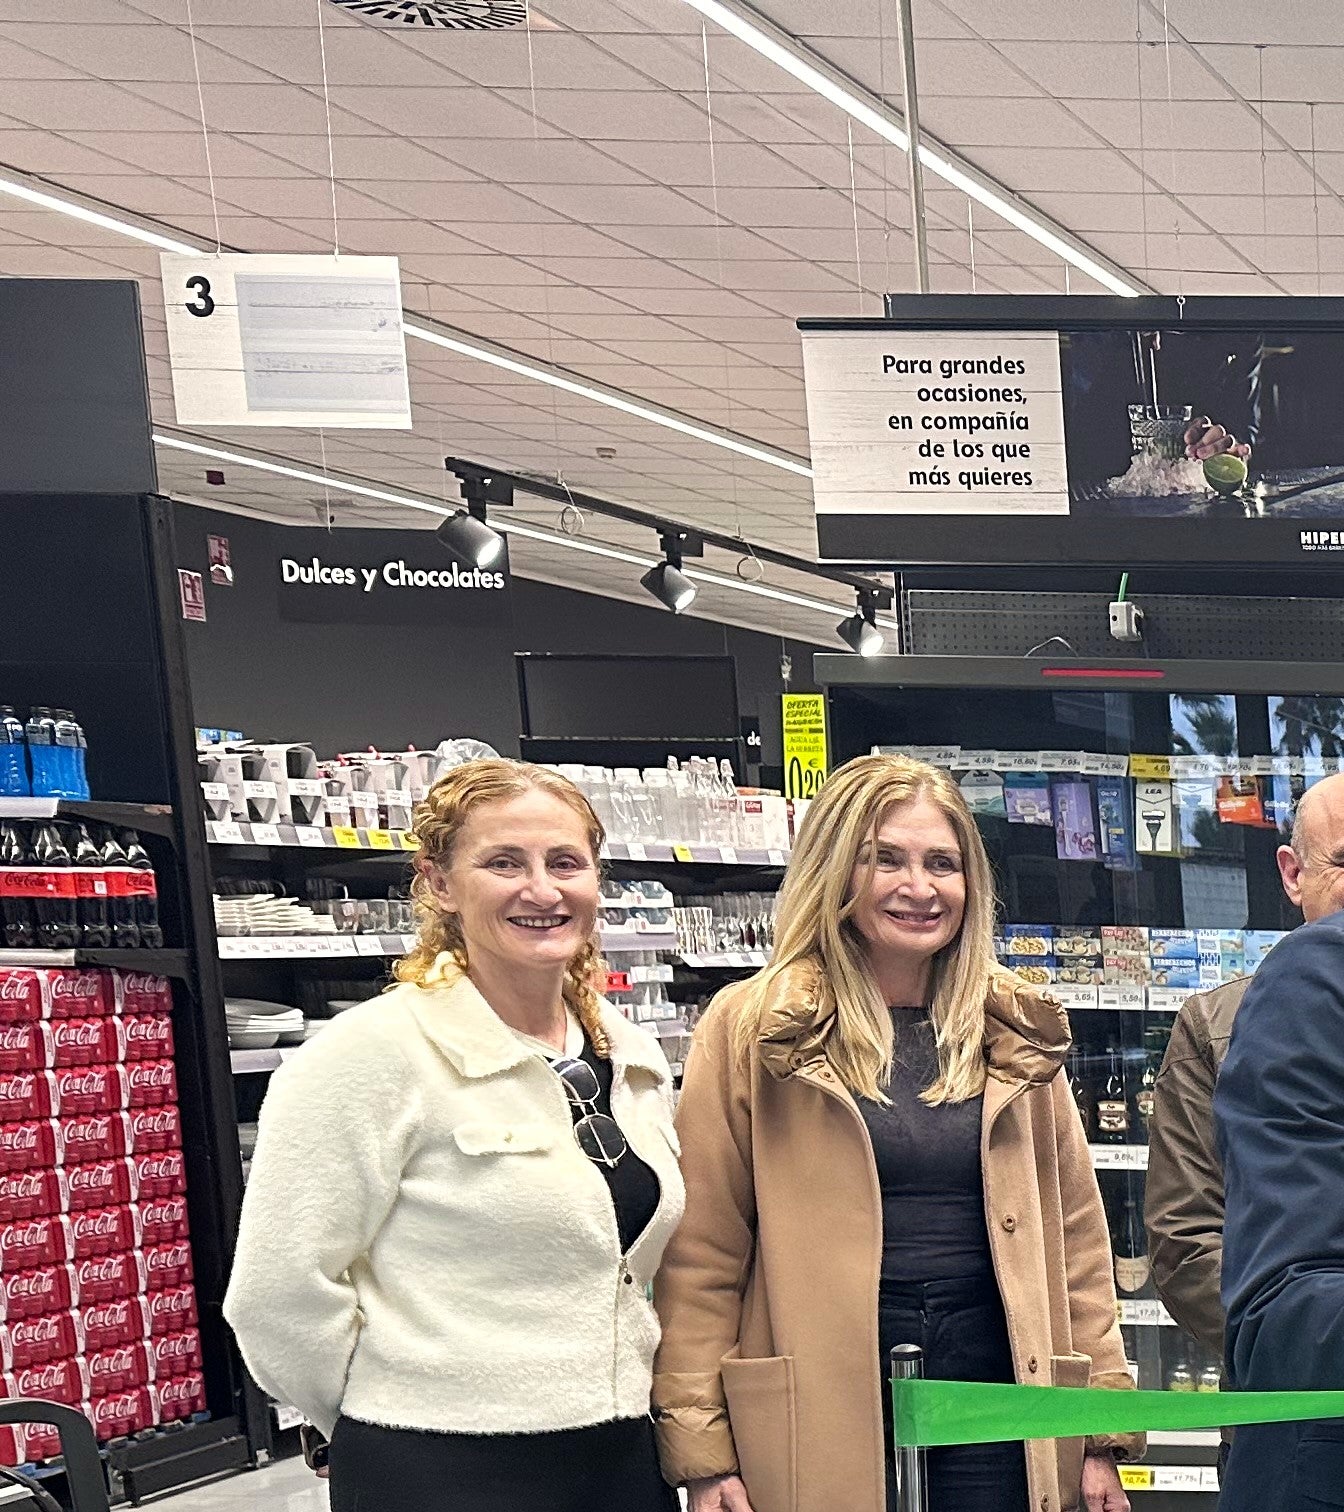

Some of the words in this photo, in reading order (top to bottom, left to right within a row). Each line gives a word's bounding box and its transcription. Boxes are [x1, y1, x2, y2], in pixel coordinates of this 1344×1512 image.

[185, 275, 216, 318] 3
[882, 355, 932, 374] Para
[939, 355, 1026, 379] grandes
[917, 383, 1028, 404] ocasiones,
[888, 415, 913, 430] en
[921, 411, 1029, 435] compañía
[918, 439, 945, 458] de
[953, 439, 984, 458] los
[991, 443, 1031, 463] que
[908, 465, 951, 485] más
[958, 467, 1033, 491] quieres
[281, 557, 356, 584] Dulces
[361, 568, 378, 592] y
[383, 560, 505, 589] Chocolates
